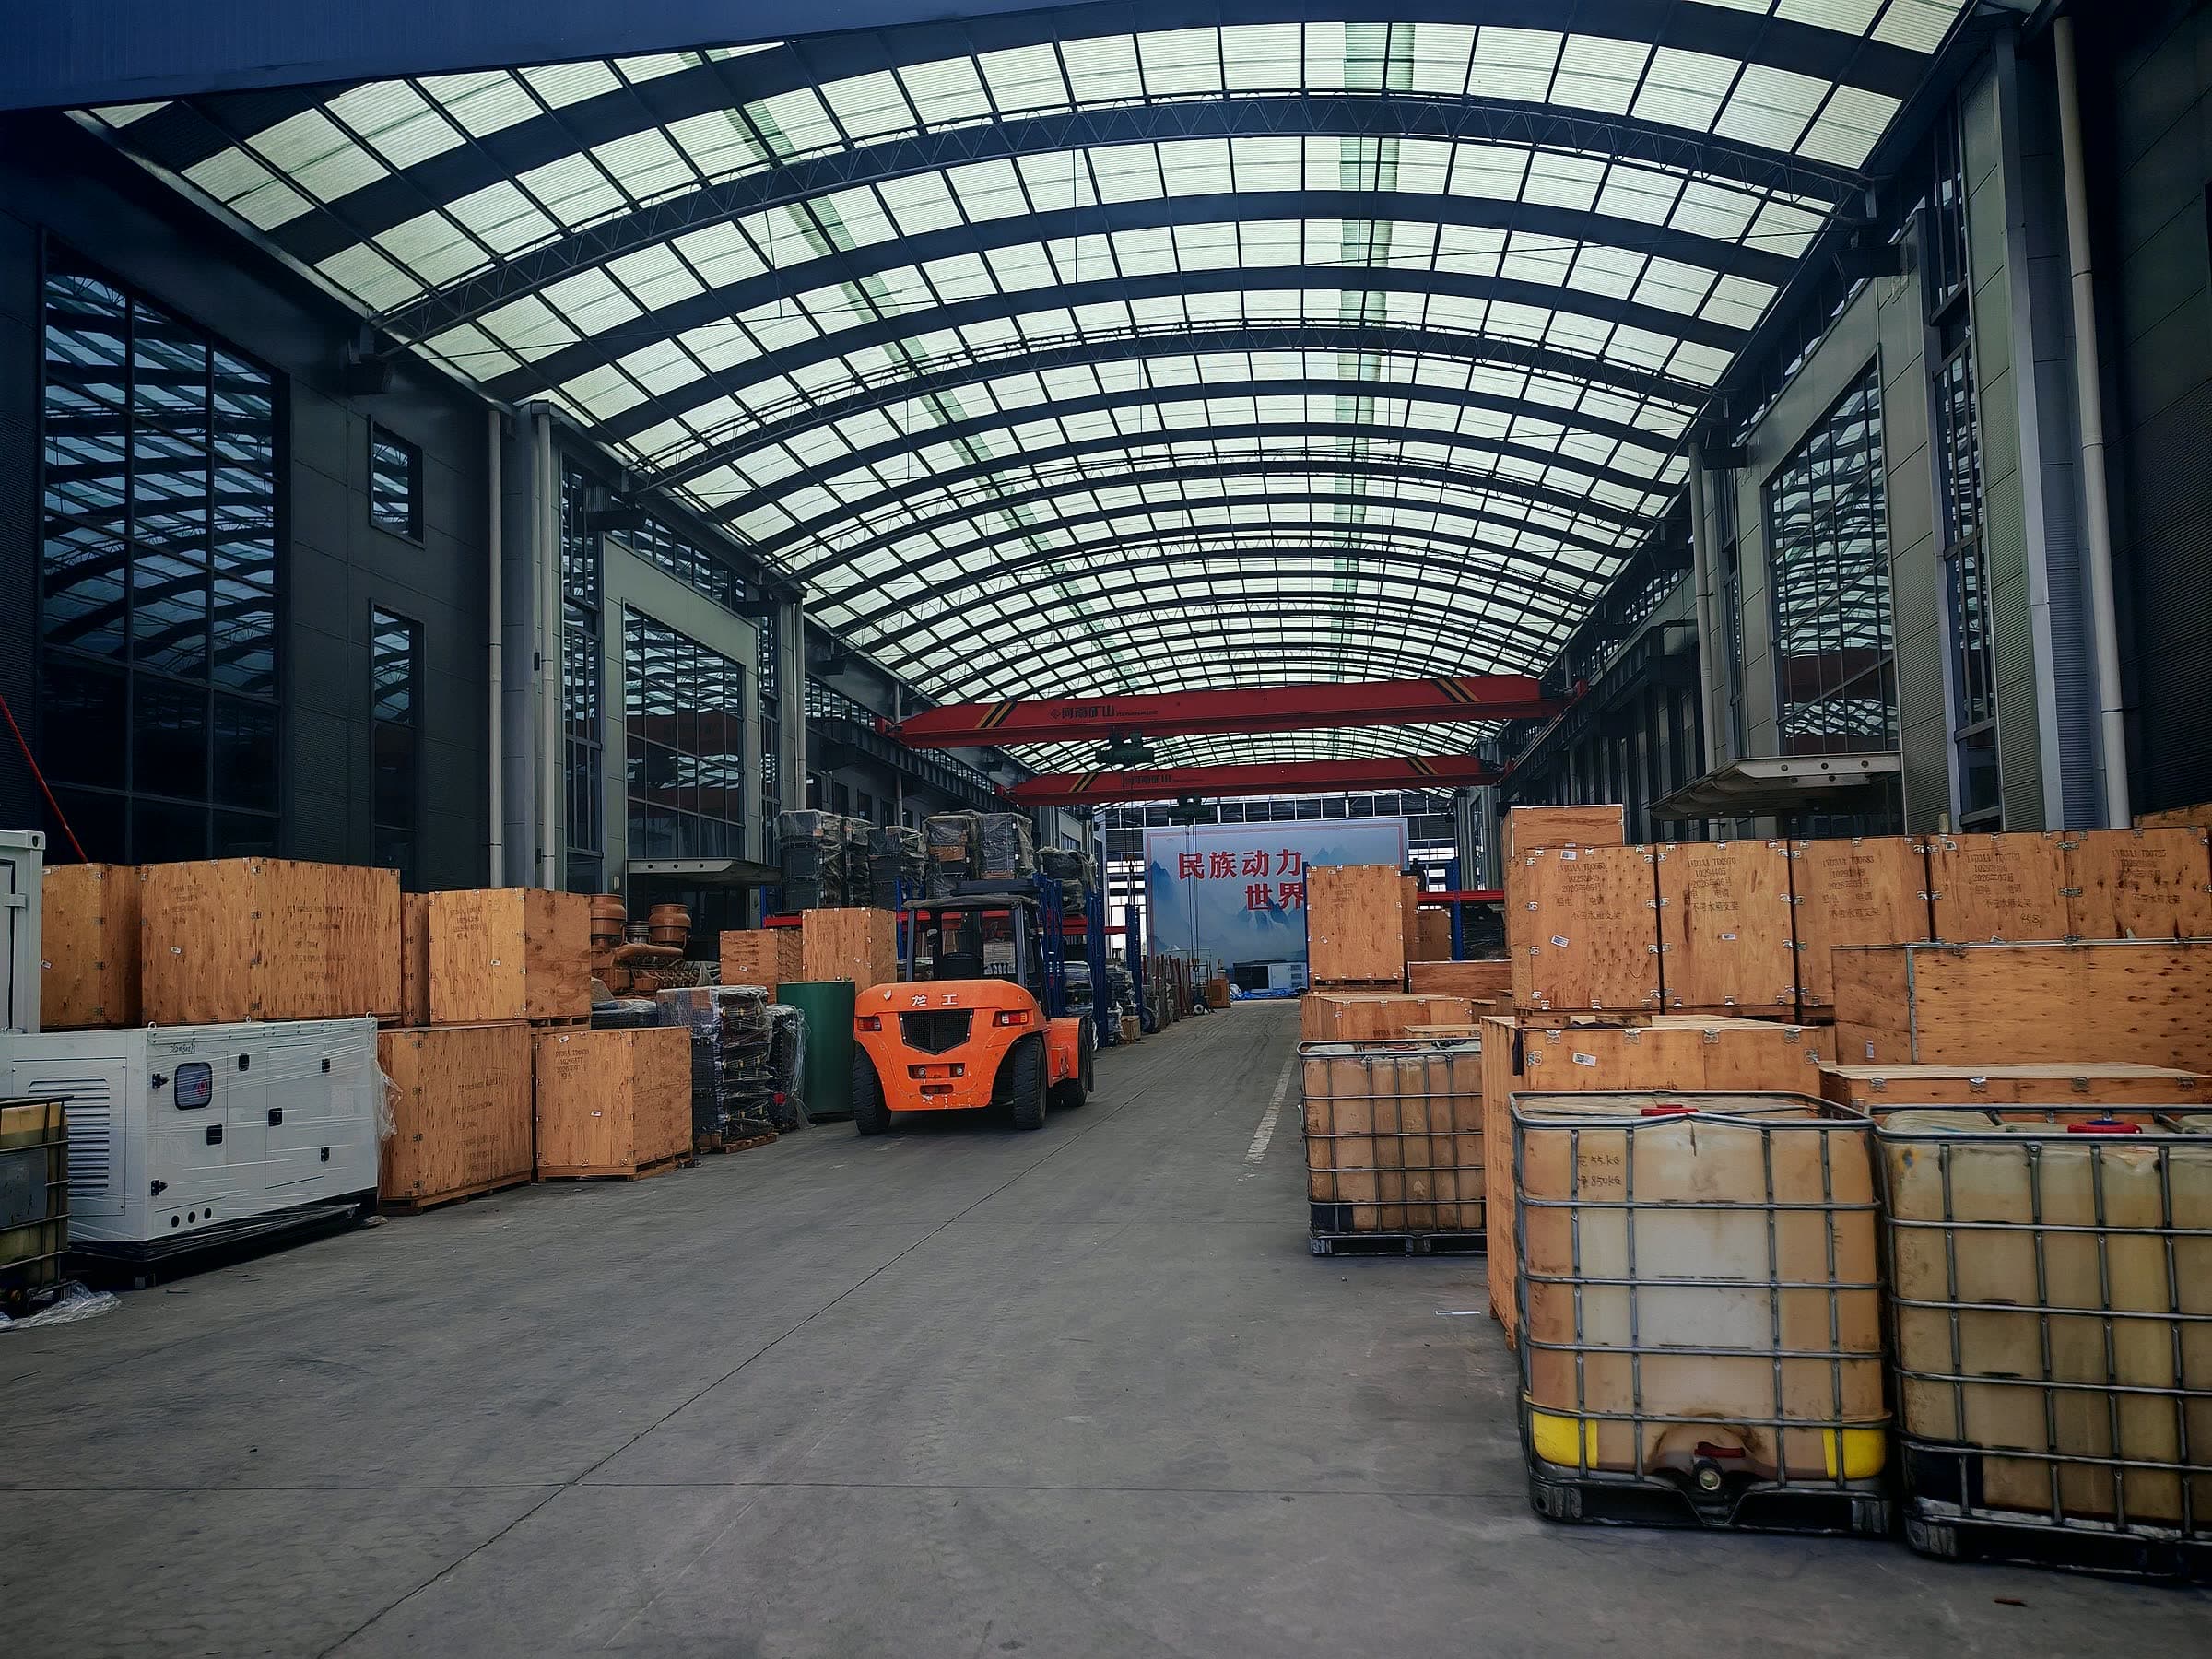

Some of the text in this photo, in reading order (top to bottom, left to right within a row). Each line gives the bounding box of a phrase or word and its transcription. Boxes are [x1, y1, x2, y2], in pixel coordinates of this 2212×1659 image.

[1178, 848, 1302, 880] 民族动力
[1244, 881, 1305, 911] 世界
[912, 994, 958, 1006] 龙工
